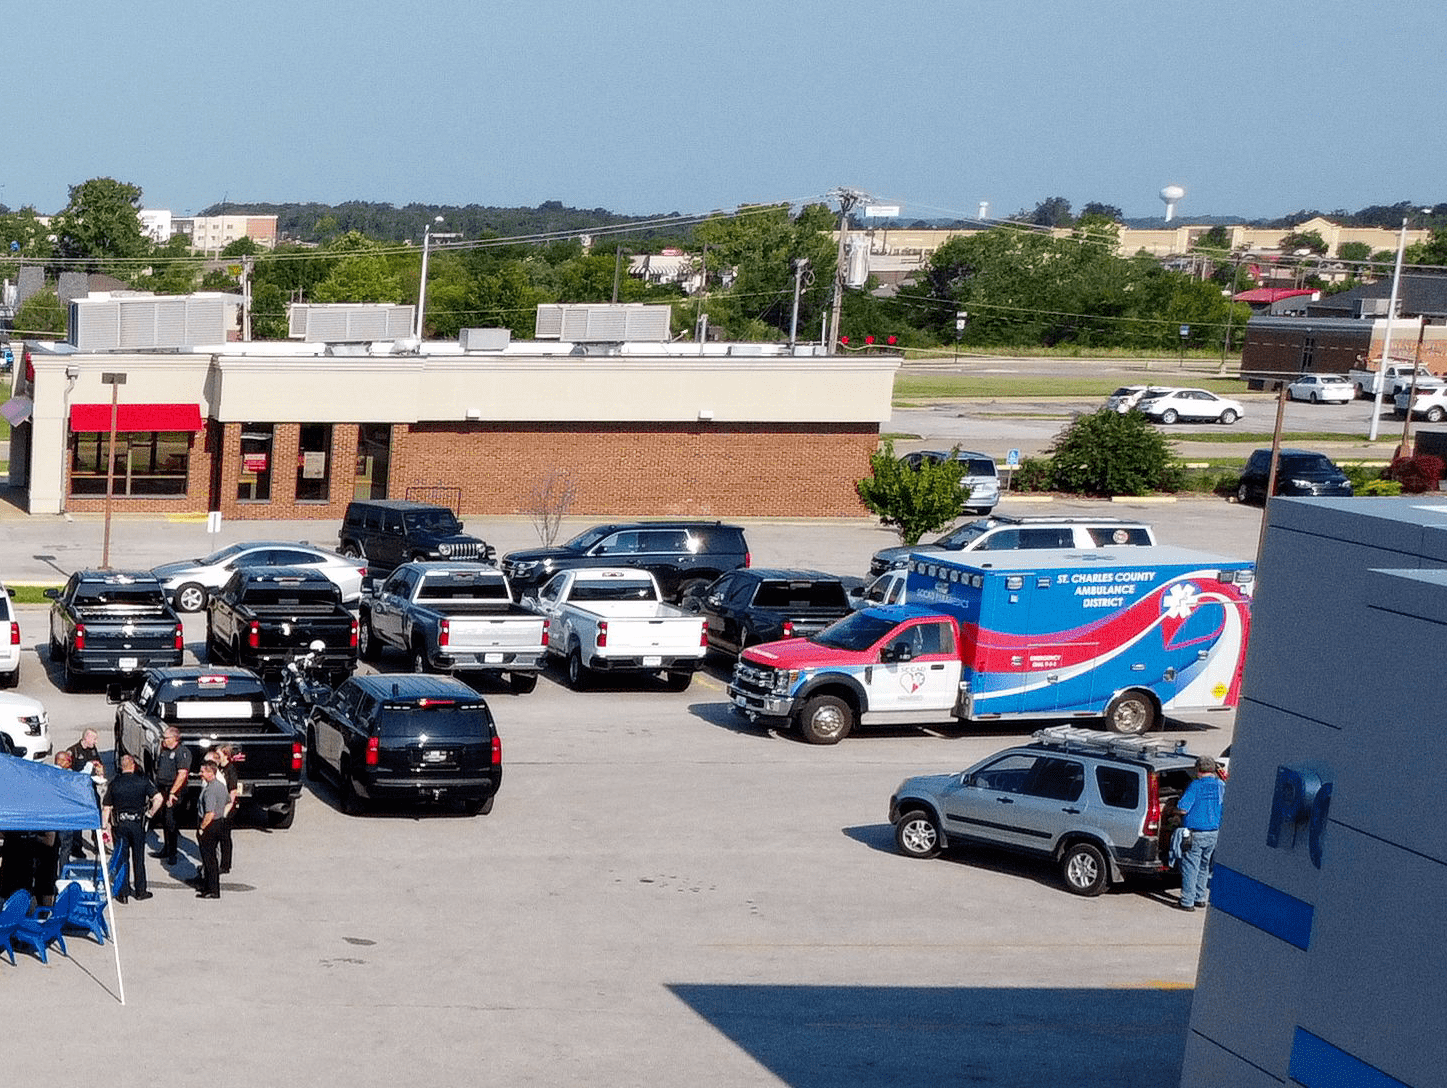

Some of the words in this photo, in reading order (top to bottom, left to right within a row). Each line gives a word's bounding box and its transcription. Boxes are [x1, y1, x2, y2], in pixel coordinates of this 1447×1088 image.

[1071, 573, 1114, 584] CHARLES
[1115, 571, 1156, 583] COUNTY
[1074, 585, 1136, 596] AMBULANCE
[1083, 597, 1124, 608] DISTRICT
